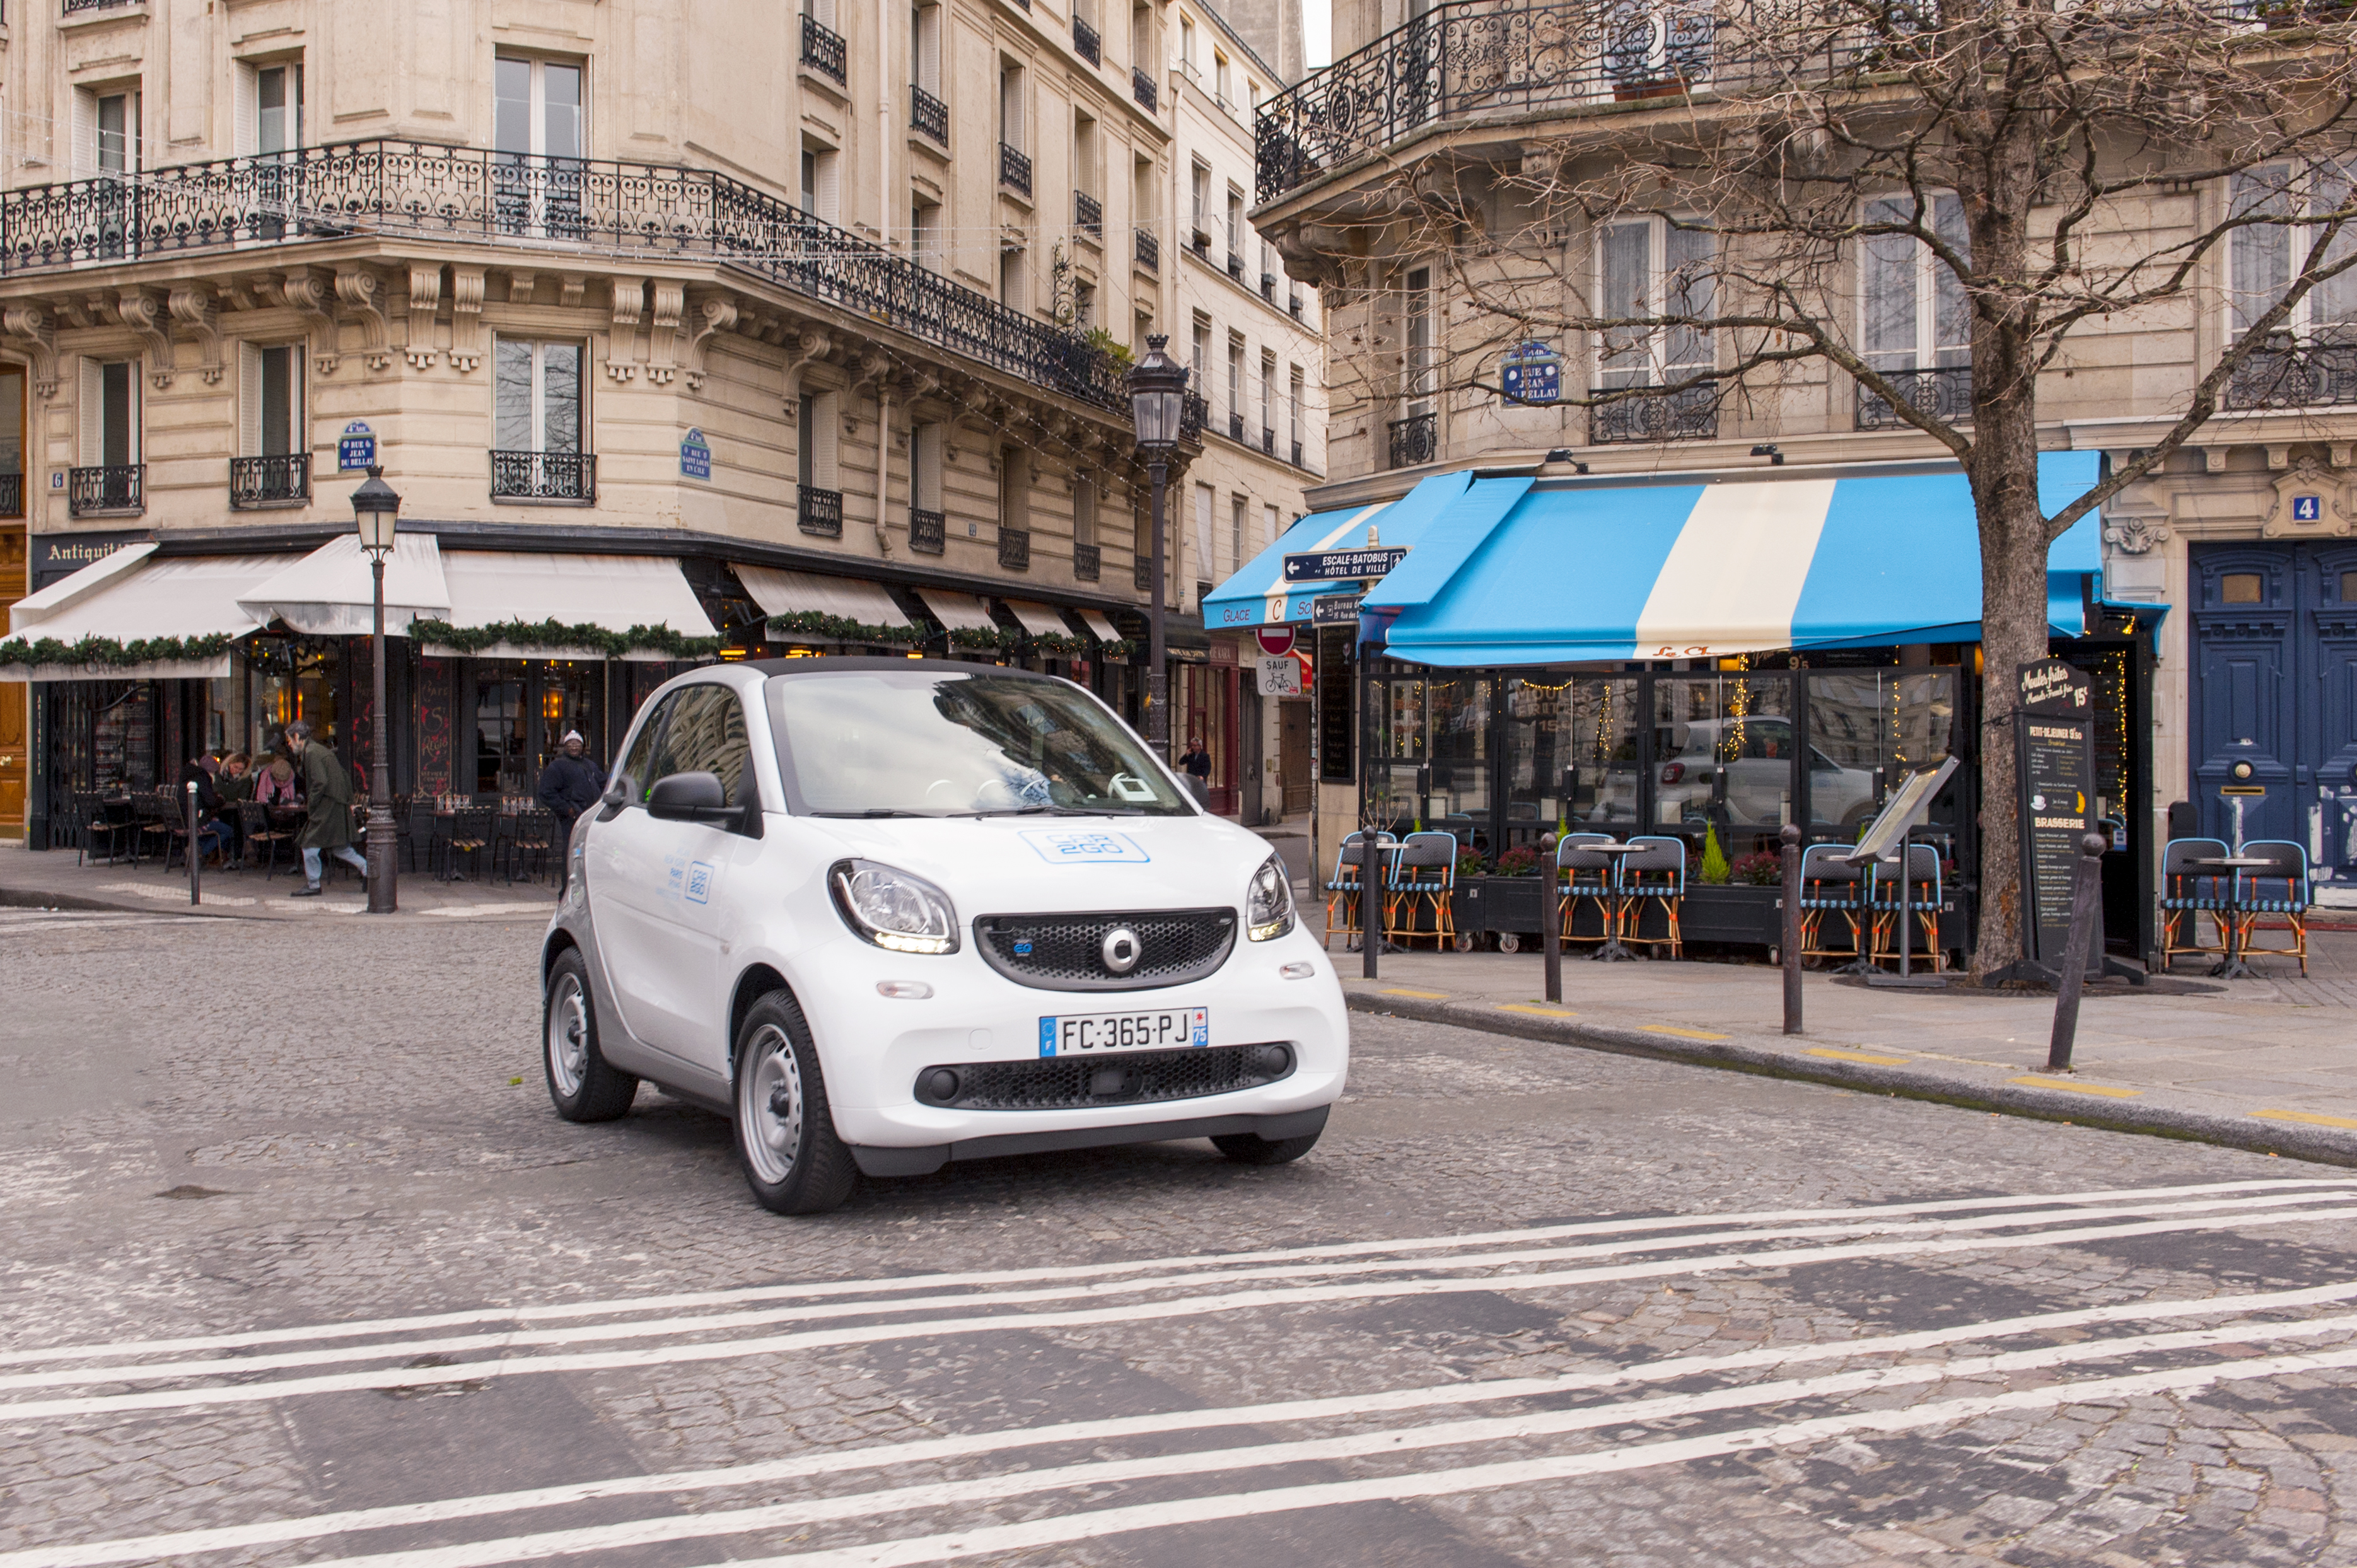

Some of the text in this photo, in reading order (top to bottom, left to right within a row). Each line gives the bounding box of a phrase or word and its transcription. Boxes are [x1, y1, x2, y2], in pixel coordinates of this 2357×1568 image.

[351, 441, 364, 449] RUE
[349, 449, 366, 457] JEAN
[351, 458, 373, 466] BELLAY
[682, 455, 709, 467] SAINT LOUIS
[54, 473, 61, 487] 6
[2298, 498, 2314, 519] 4
[1325, 564, 1387, 576] HÔTEL DE VILLE
[1297, 601, 1312, 615] SO
[1334, 600, 1353, 610] Bureau
[1223, 608, 1250, 622] GLACE
[1266, 661, 1289, 670] SAUF
[2022, 665, 2069, 692] Moules frites
[2034, 816, 2085, 830] BRASSERIE
[1045, 834, 1114, 844] CAR
[1056, 844, 1124, 854] 2GO
[1194, 1027, 1207, 1043] 75
[1045, 1040, 1052, 1050] F
